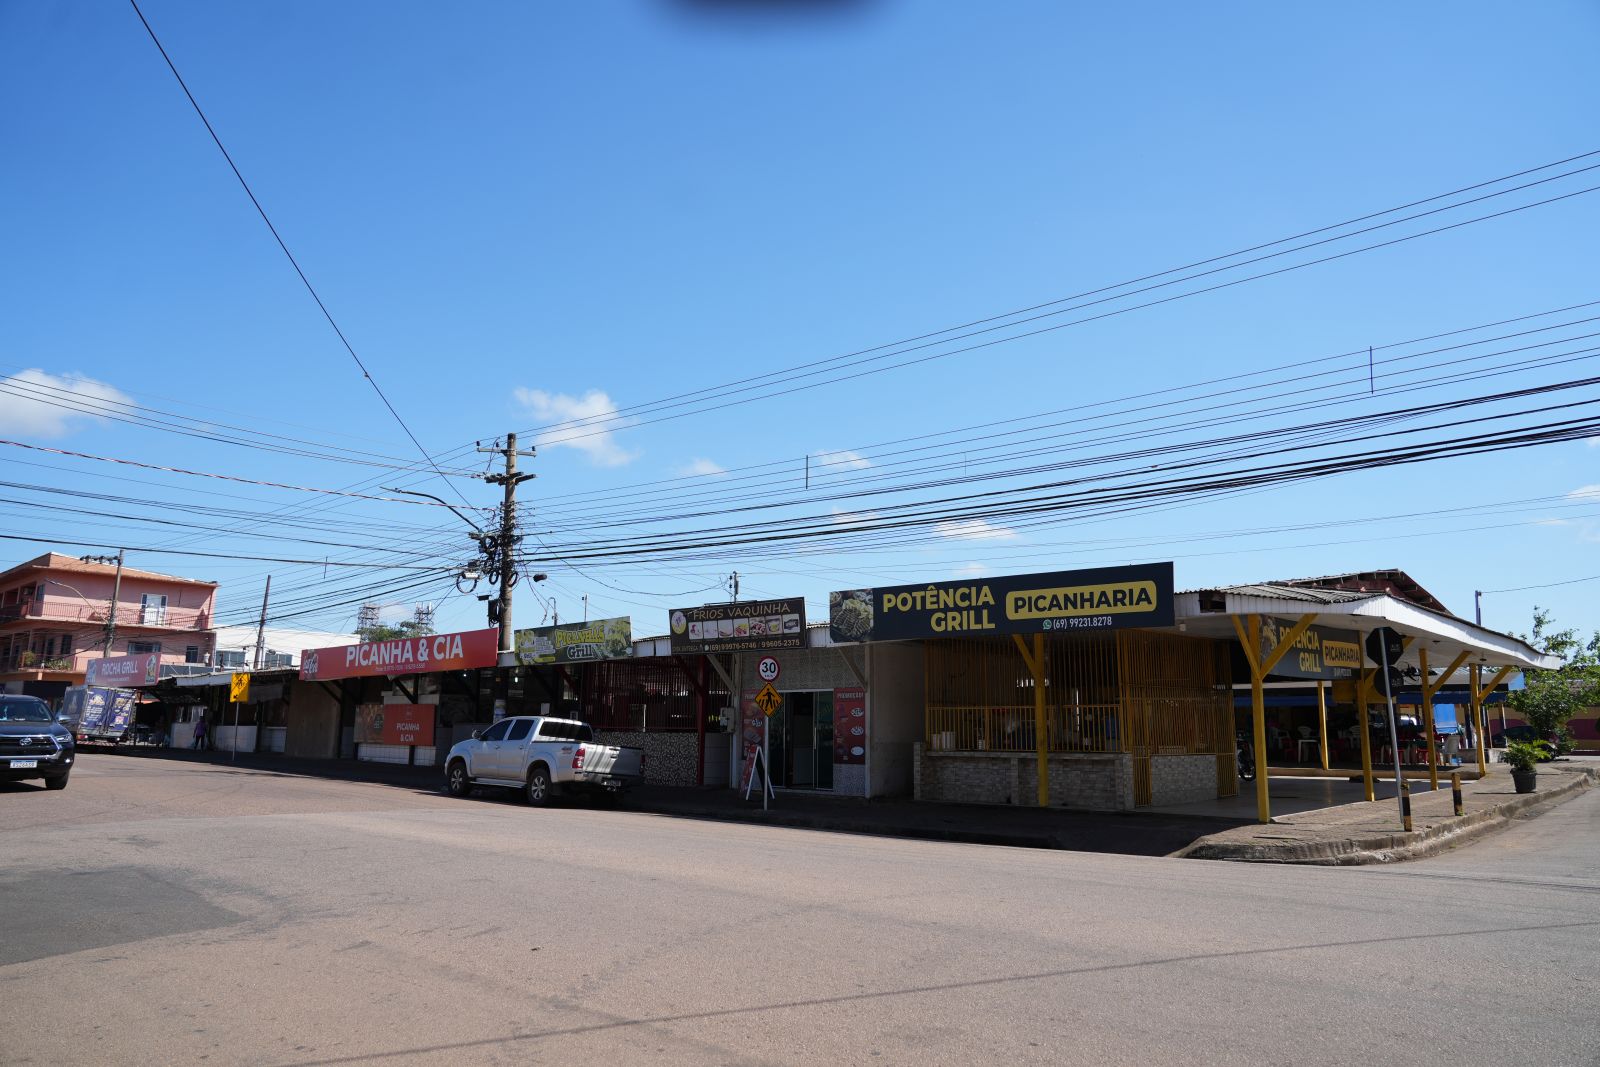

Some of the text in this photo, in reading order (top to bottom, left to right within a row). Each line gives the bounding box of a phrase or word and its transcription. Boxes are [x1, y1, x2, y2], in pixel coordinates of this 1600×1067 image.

[882, 585, 995, 612] POTÊNCIA
[1014, 587, 1152, 613] PICANHARIA
[693, 603, 790, 620] FRIOS VAQUINHA
[930, 609, 995, 632] GRILL
[1053, 616, 1112, 629] (69) 99231.8278
[1279, 626, 1320, 650] PNCIA
[346, 640, 413, 667] PICANHA
[417, 638, 429, 661] &
[433, 635, 463, 660] CIA
[567, 645, 593, 659] Grill
[1325, 645, 1360, 663] PICANHARIA
[101, 660, 138, 675] ROCHA GRILL
[762, 662, 776, 673] 30
[1299, 651, 1321, 672] GRILL
[396, 722, 420, 731] PICANHA
